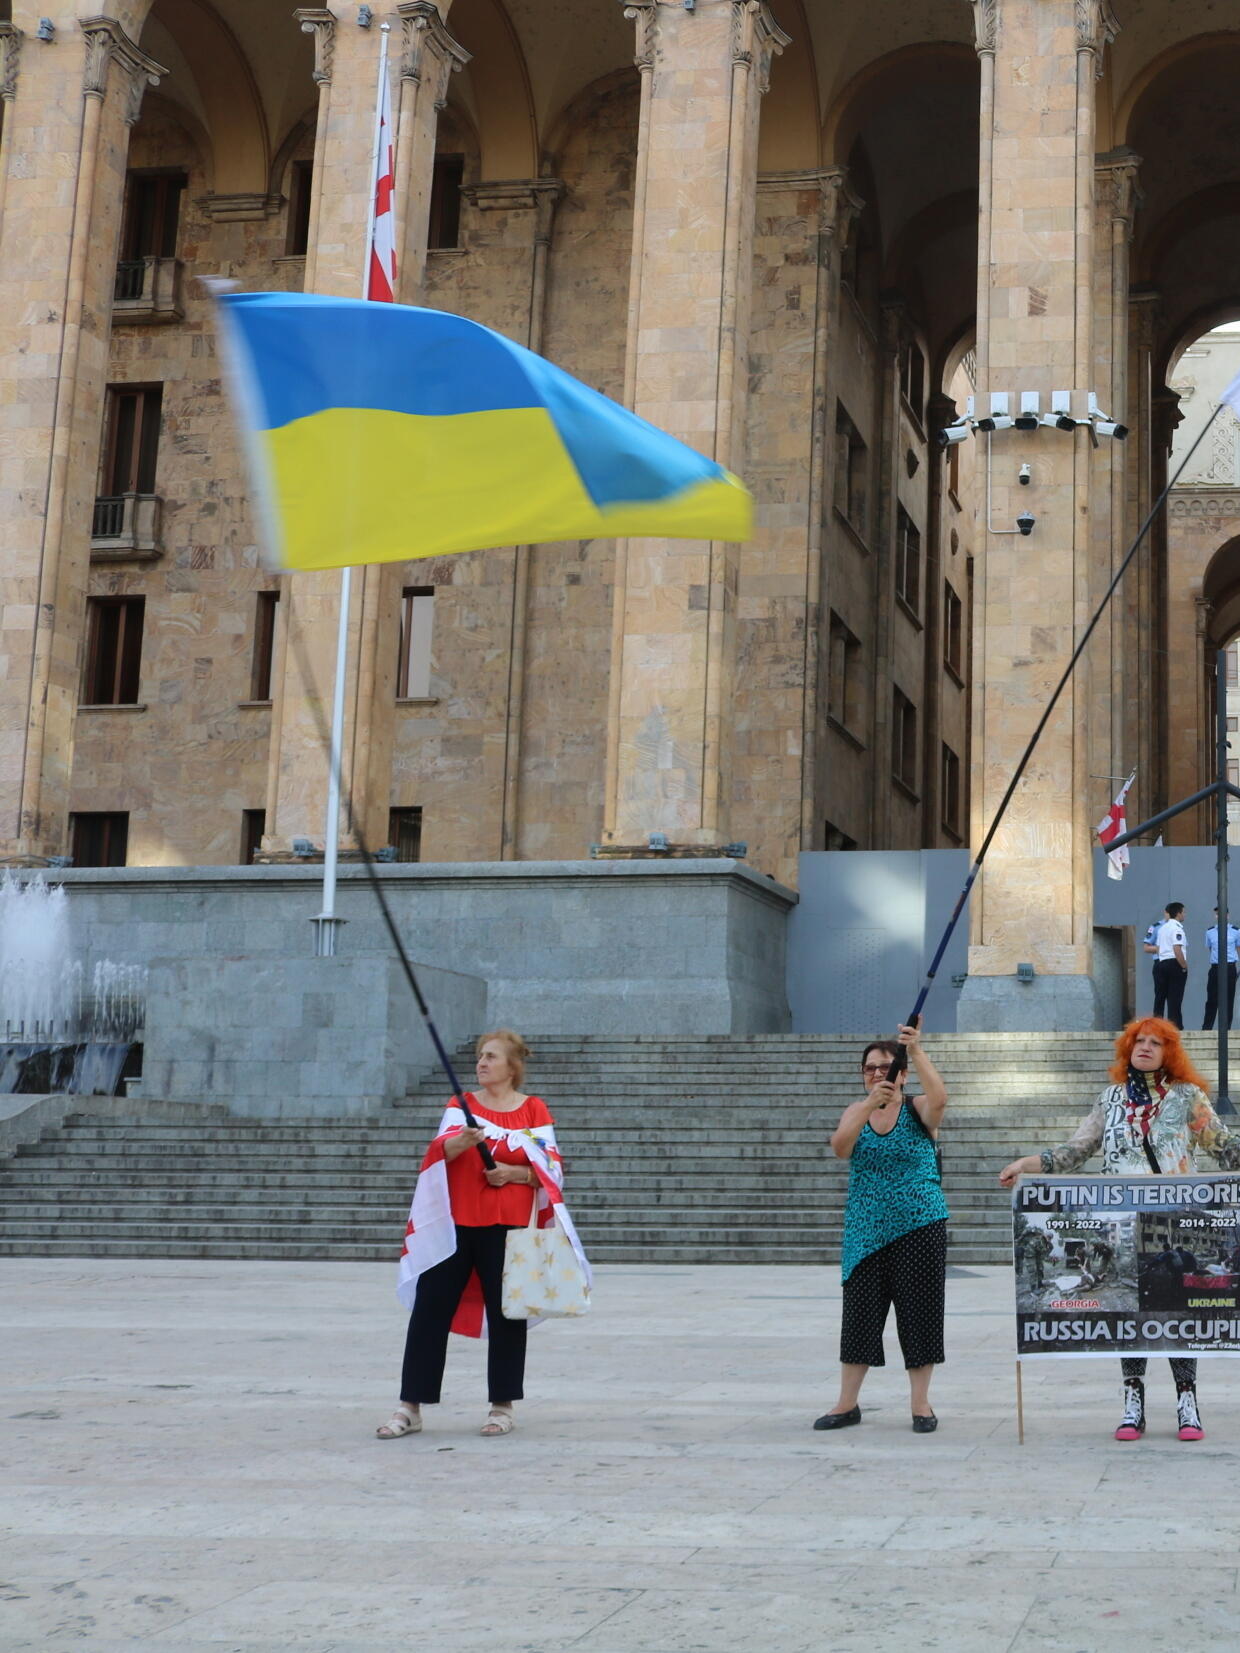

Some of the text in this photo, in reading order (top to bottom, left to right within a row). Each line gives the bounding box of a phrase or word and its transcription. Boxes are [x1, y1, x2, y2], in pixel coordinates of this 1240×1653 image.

[1022, 1185, 1098, 1206] PUTIN
[1103, 1185, 1124, 1205] IS
[1051, 1299, 1100, 1308] GEORGIA
[1187, 1298, 1236, 1308] UKRAINE
[1024, 1320, 1112, 1341] RUSSIA
[1116, 1321, 1137, 1340] IS
